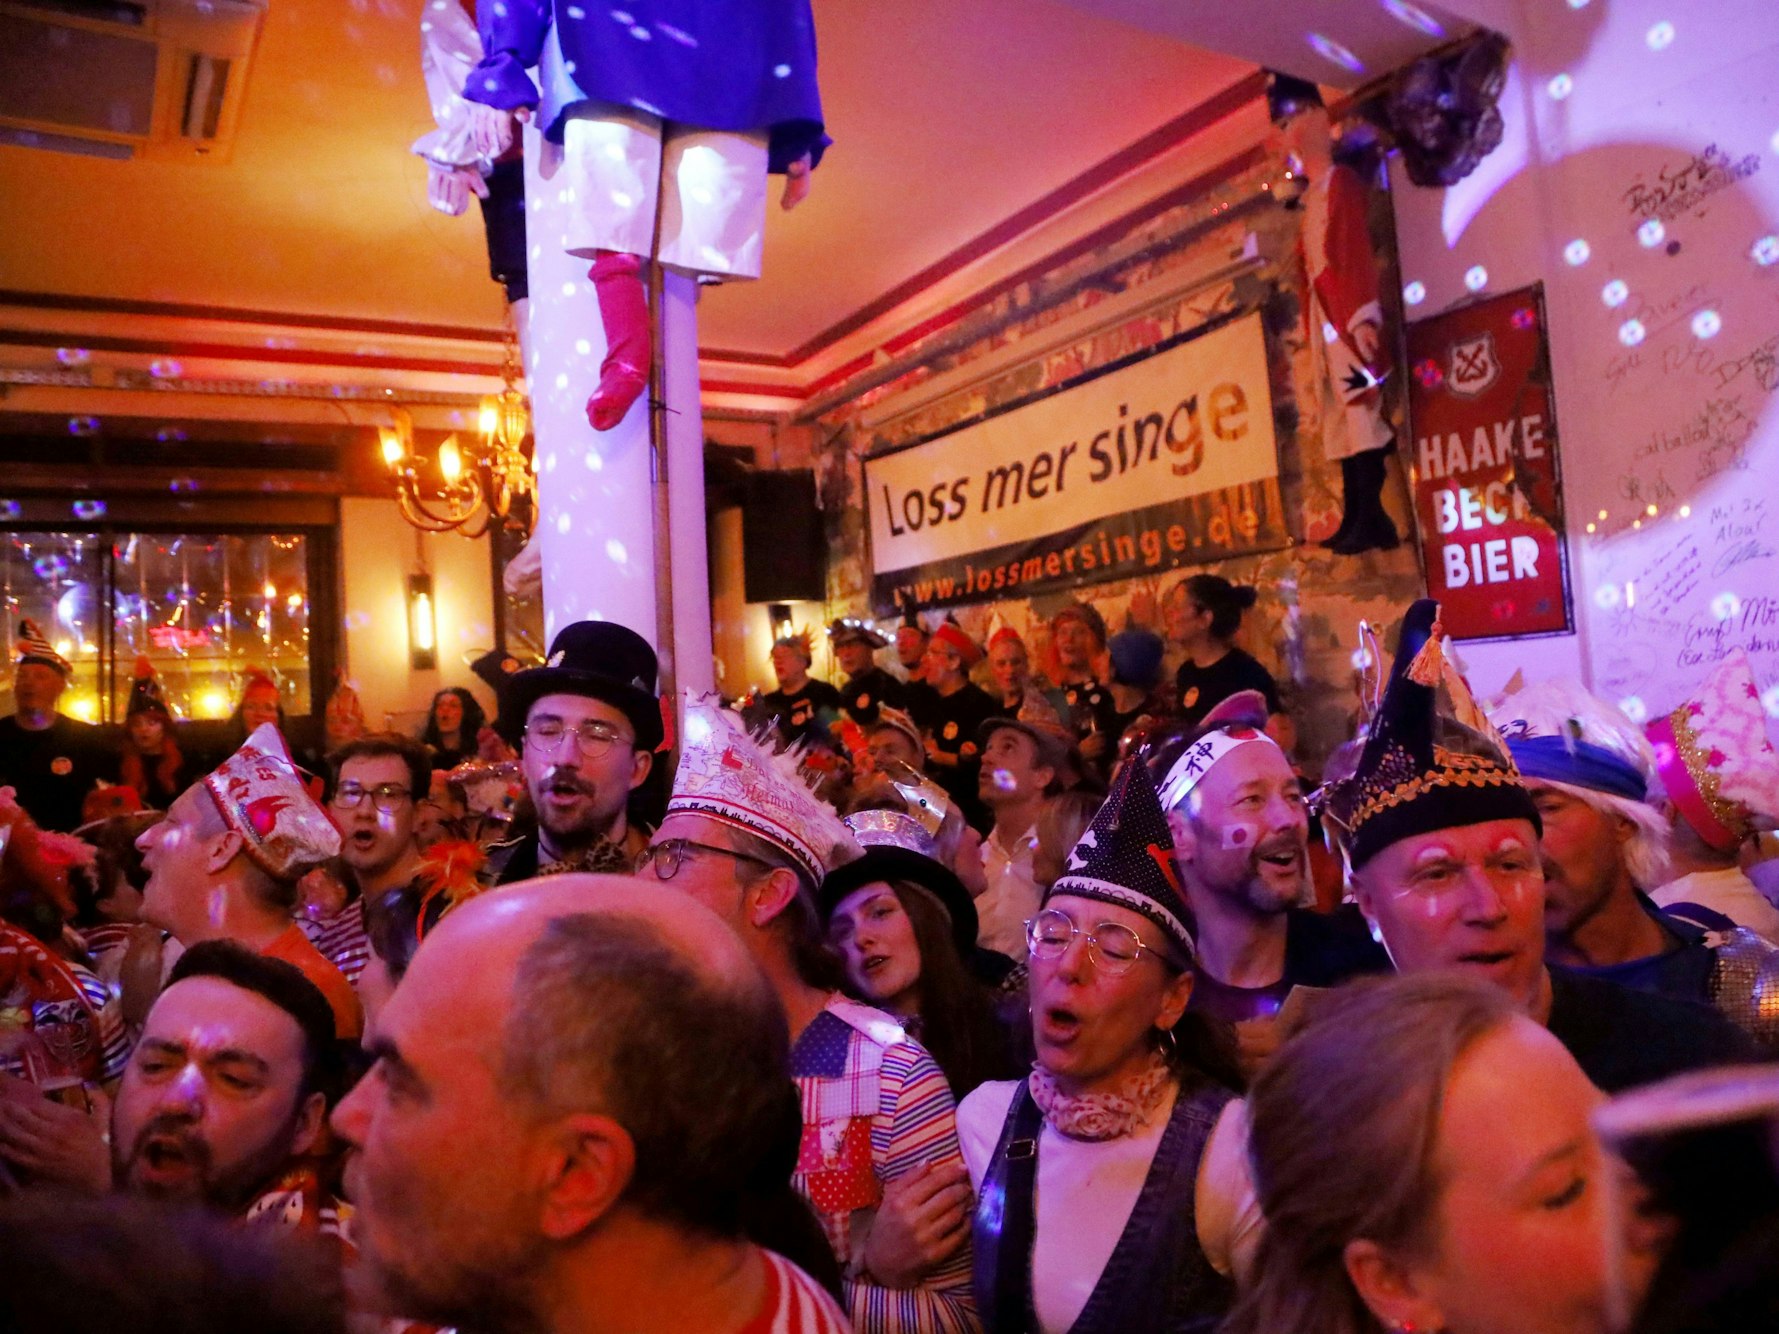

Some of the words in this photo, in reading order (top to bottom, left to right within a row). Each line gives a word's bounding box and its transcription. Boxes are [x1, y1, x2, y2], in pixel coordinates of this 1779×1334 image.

[882, 475, 970, 538] Loss
[981, 440, 1078, 513] mer
[1089, 381, 1250, 483] singe
[1418, 413, 1545, 481] HAAKE
[1443, 535, 1540, 589] BIER
[1184, 742, 1214, 777] 神
